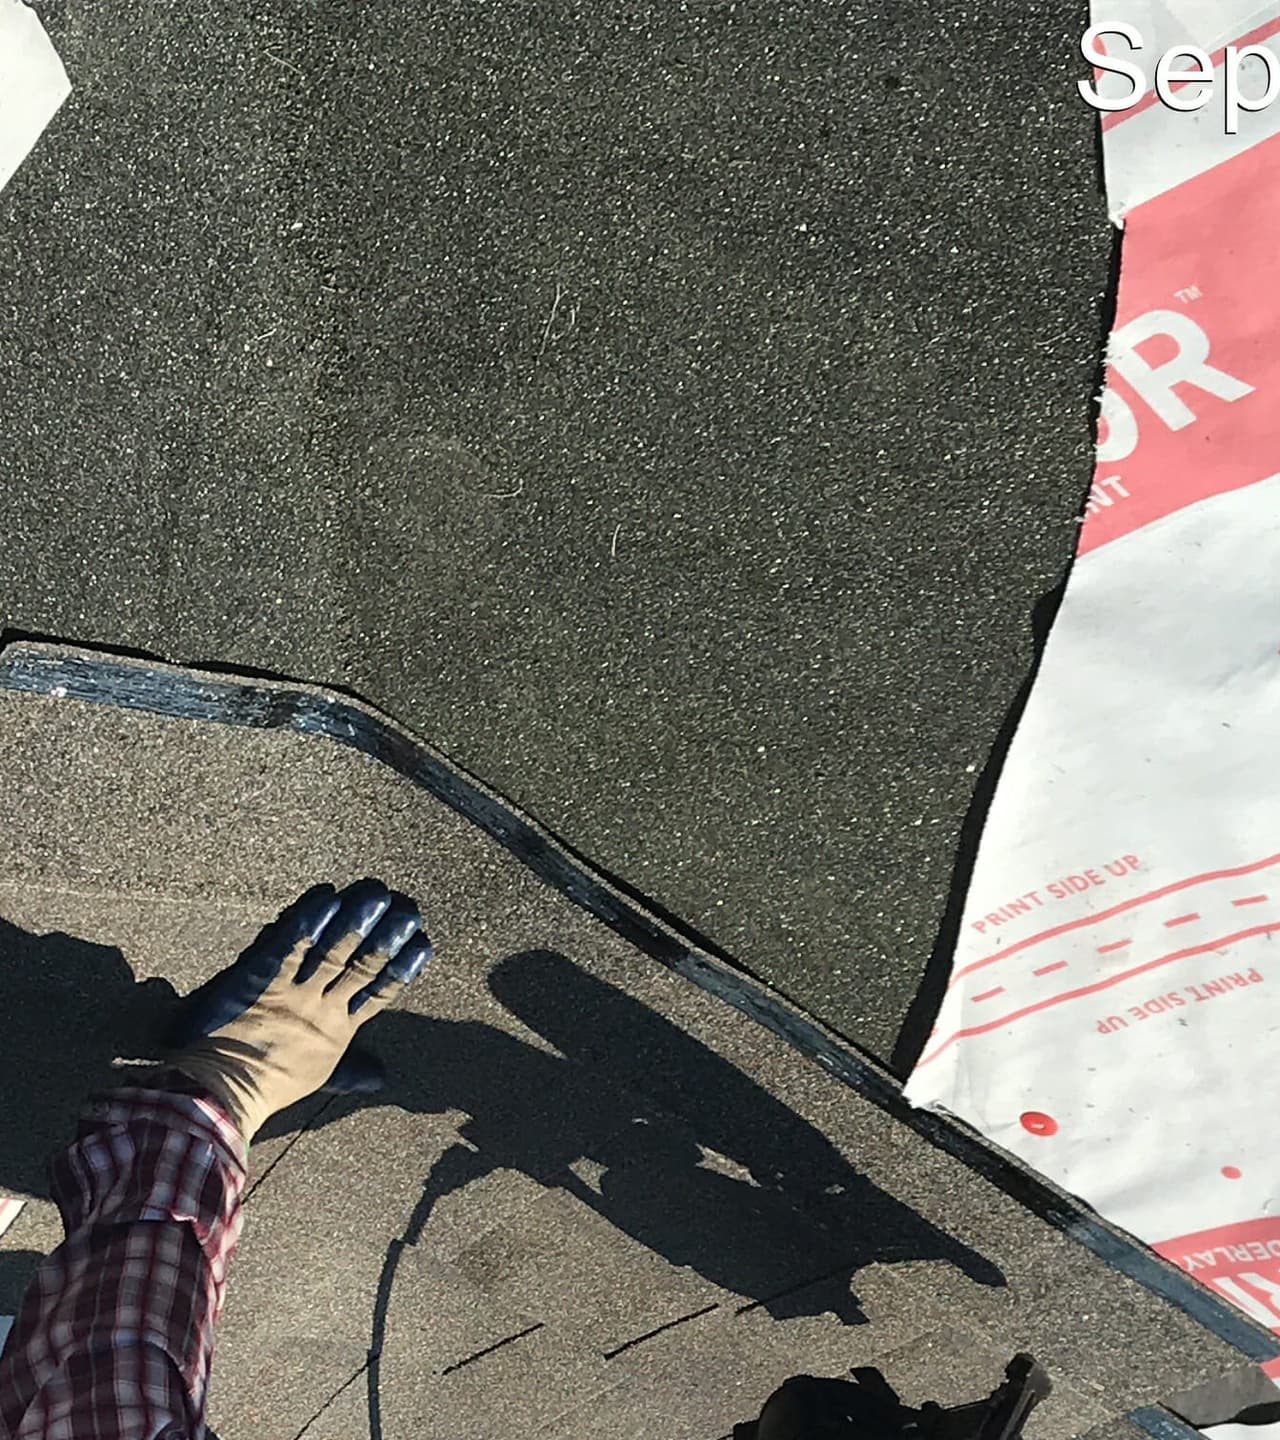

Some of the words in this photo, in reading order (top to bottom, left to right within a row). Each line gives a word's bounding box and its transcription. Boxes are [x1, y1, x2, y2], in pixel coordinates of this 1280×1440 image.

[971, 891, 1043, 935] PRINT
[1045, 870, 1103, 899] SIDE
[1104, 855, 1143, 876] UP
[1188, 969, 1263, 1000] PRINT
[1127, 992, 1187, 1021] SIDE
[1093, 1014, 1128, 1034] UP
